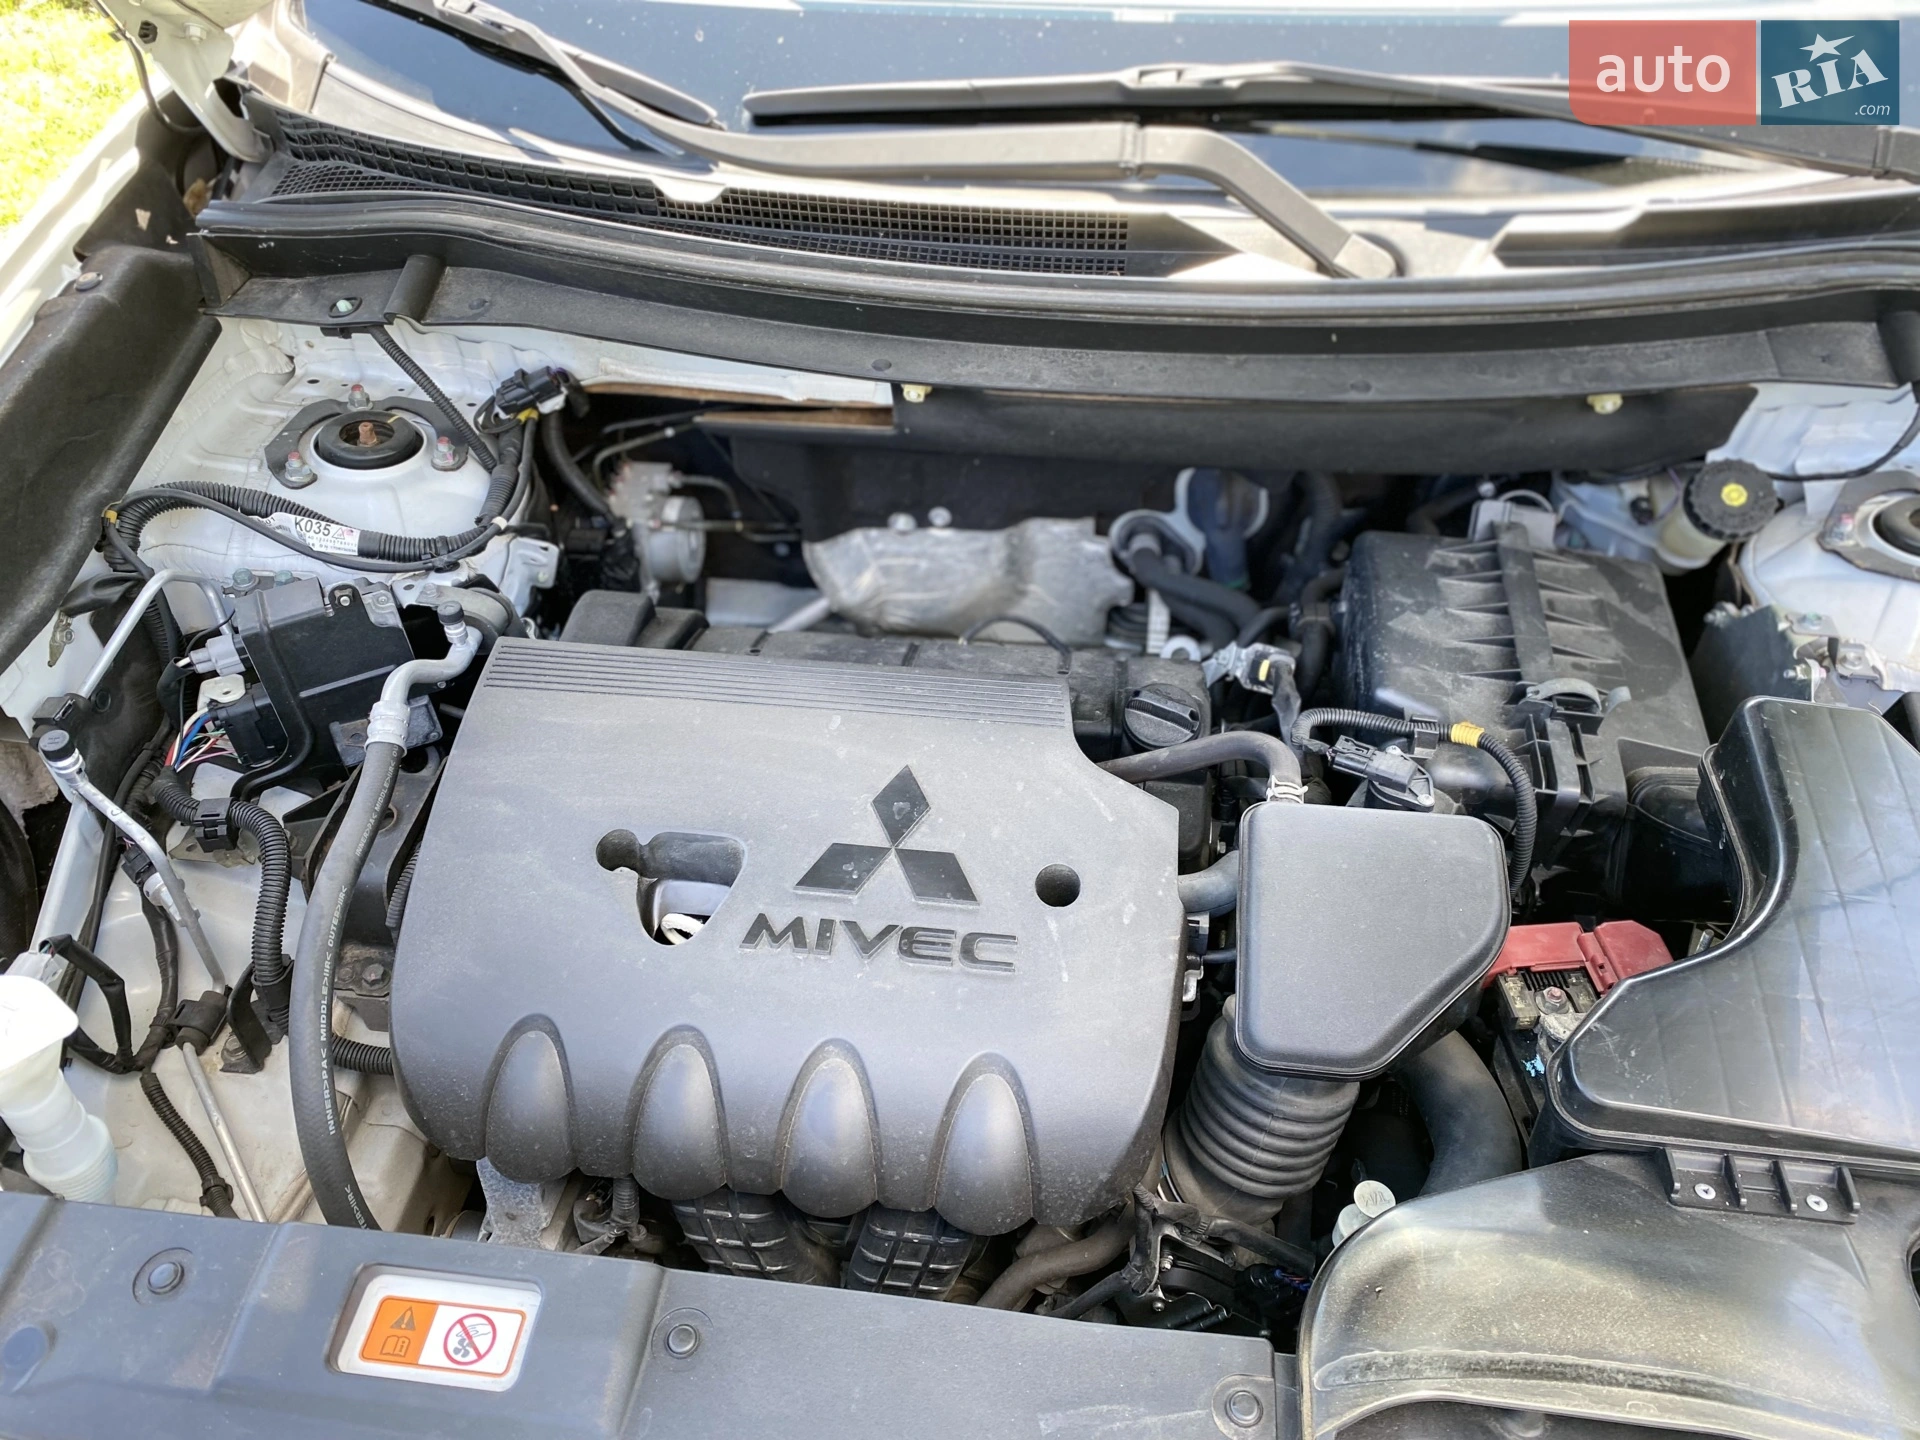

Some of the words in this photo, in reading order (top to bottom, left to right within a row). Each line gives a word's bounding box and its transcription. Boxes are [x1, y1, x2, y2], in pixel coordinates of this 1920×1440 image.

[294, 516, 333, 537] K035
[738, 912, 1018, 973] MIVEC
[320, 1047, 335, 1136] INNER>PA<
